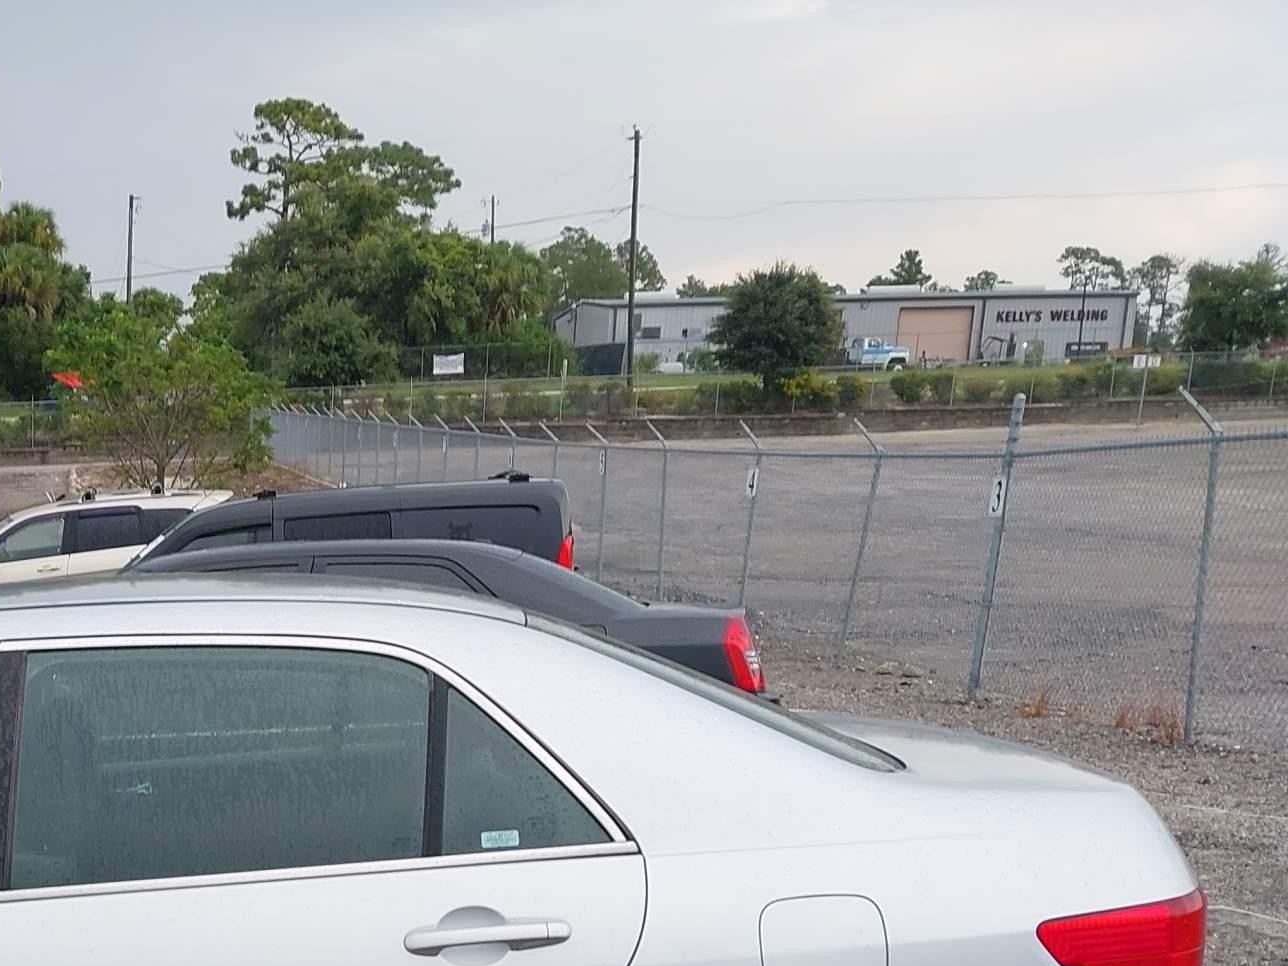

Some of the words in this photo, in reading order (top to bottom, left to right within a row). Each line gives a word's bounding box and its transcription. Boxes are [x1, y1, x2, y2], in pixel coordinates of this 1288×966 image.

[996, 309, 1043, 322] KELLY'S
[1050, 308, 1108, 321] WELDING
[748, 469, 756, 495] 4
[991, 479, 1002, 513] 3
